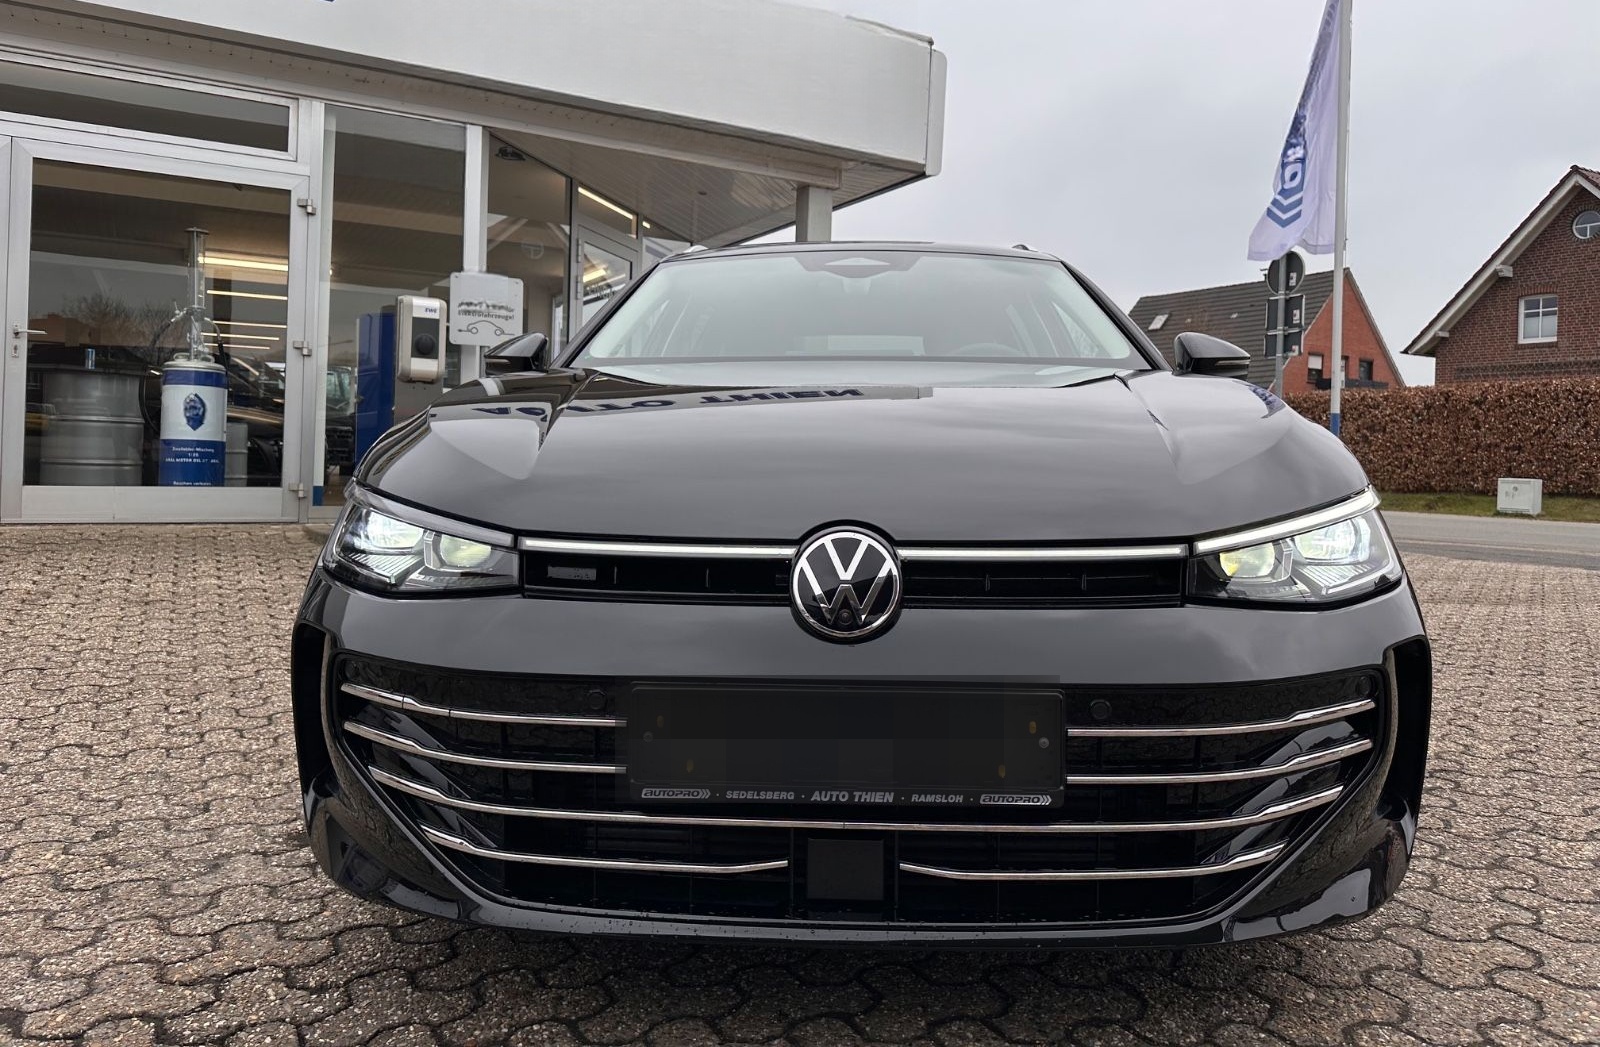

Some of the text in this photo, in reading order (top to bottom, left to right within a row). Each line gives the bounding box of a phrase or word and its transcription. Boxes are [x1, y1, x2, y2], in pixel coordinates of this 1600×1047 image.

[725, 790, 795, 800] SEDELSBERG
[810, 790, 849, 802] AUTO
[853, 791, 895, 803] THIEN
[911, 793, 964, 803] RAMSLOH
